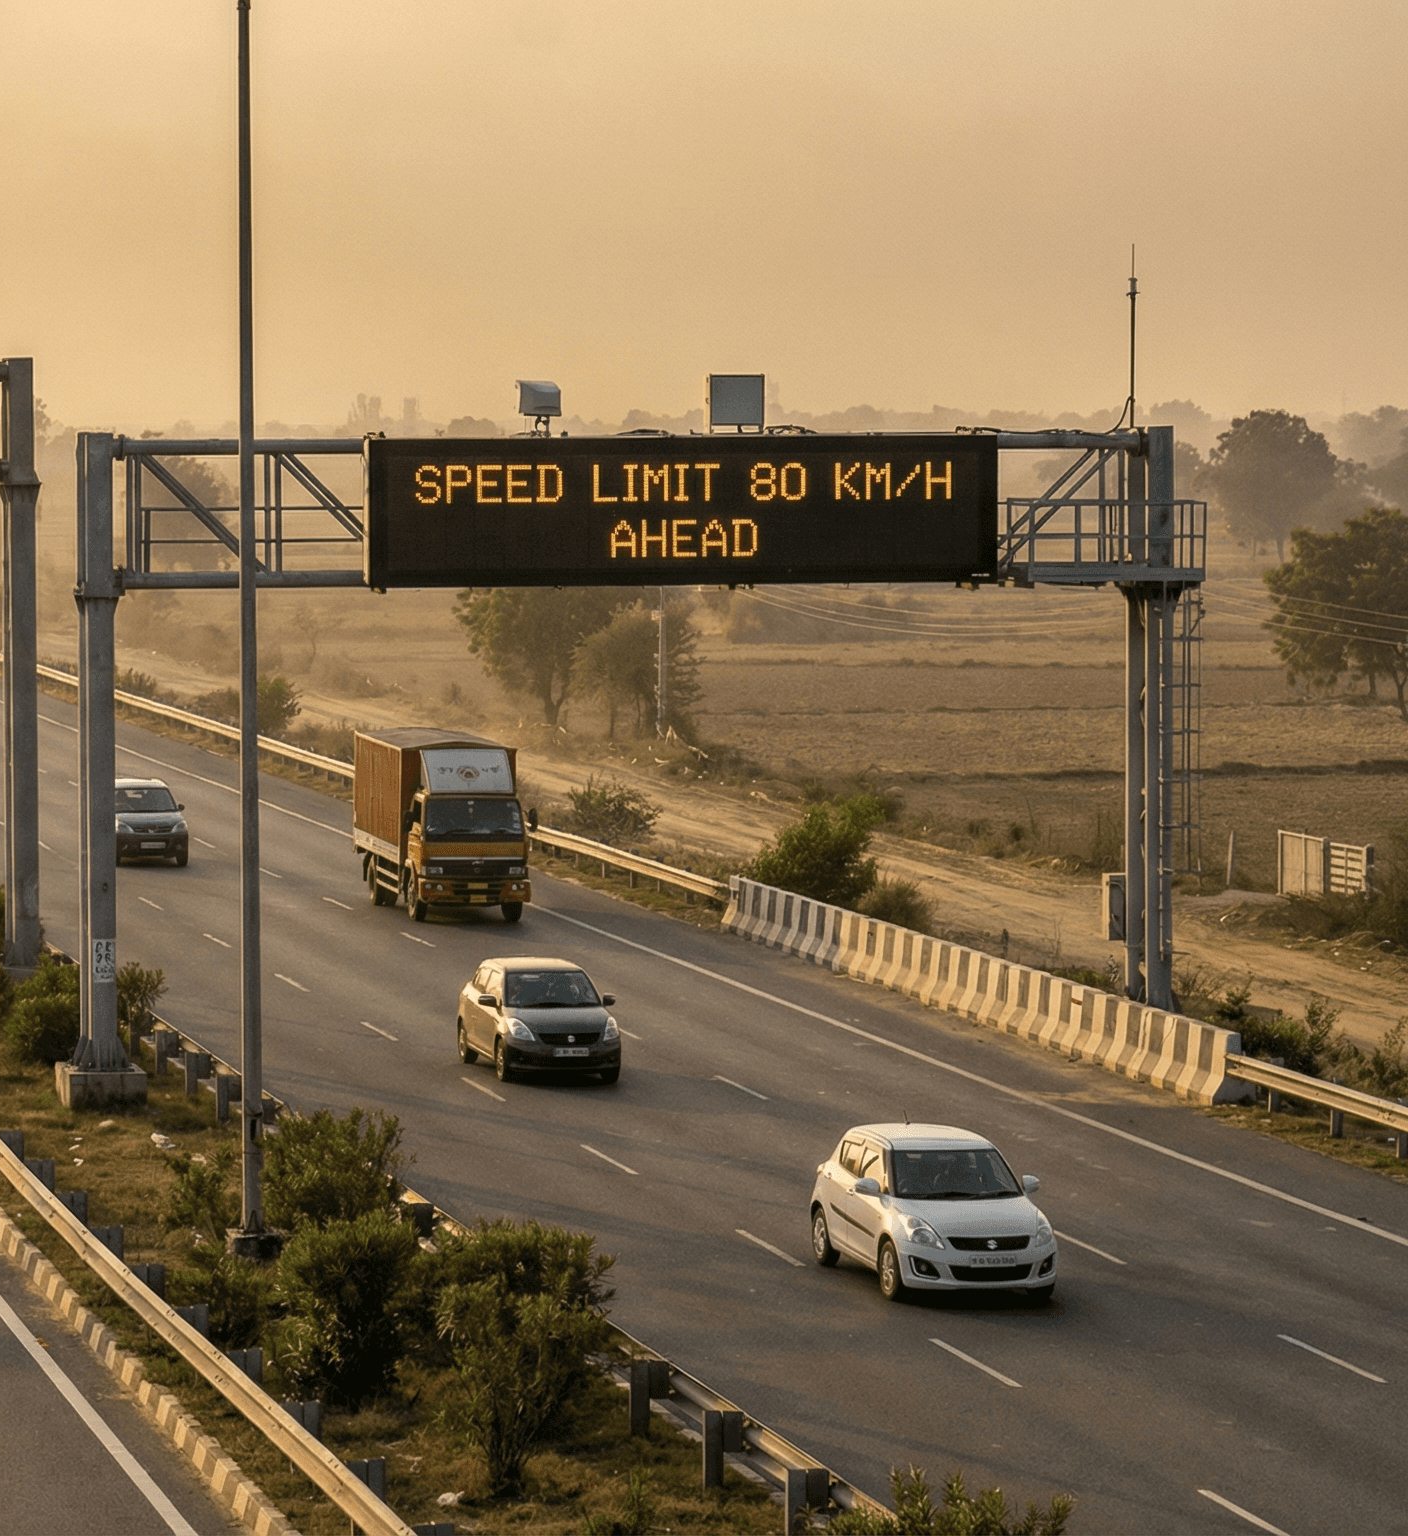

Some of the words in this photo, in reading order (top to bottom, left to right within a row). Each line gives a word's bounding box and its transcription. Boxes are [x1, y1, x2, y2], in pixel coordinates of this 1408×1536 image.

[414, 463, 564, 505] SPEED
[592, 462, 721, 503] LIMIT
[750, 461, 807, 502] 80
[834, 460, 953, 501] KM/H
[610, 518, 759, 559] AHEAD
